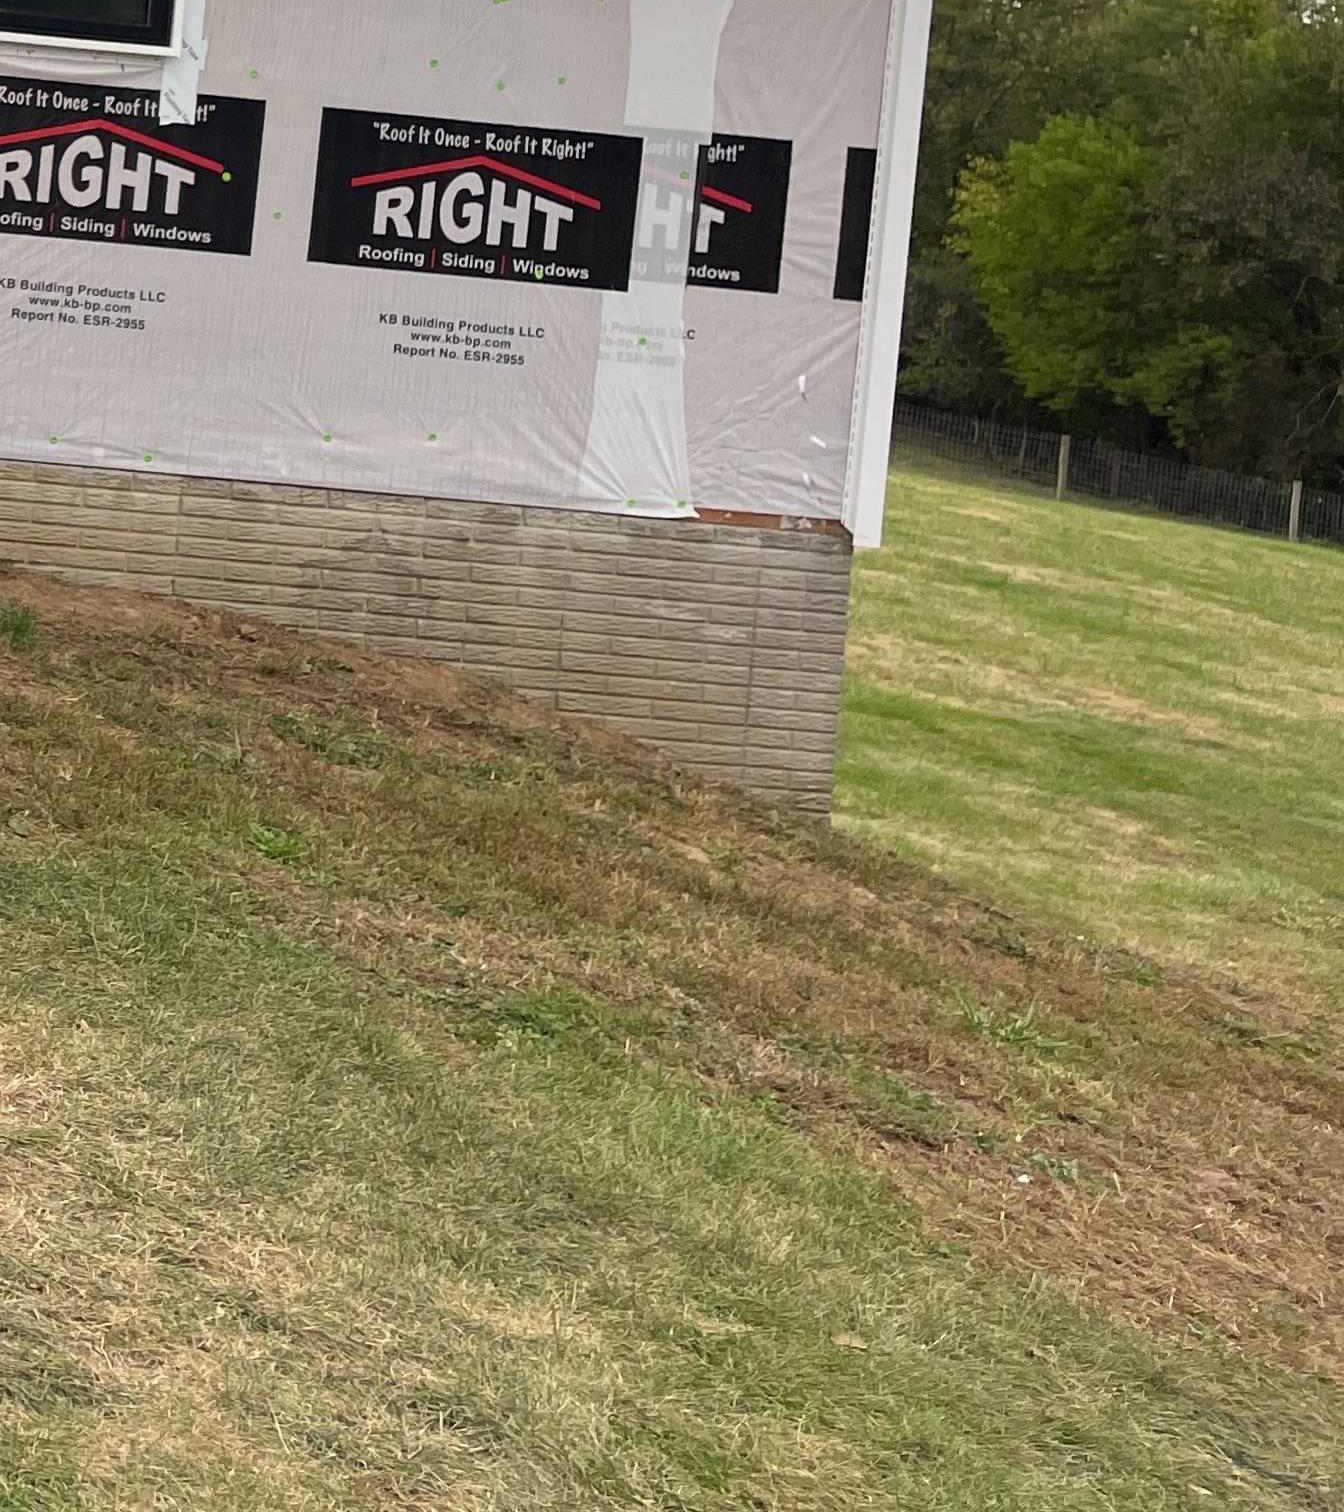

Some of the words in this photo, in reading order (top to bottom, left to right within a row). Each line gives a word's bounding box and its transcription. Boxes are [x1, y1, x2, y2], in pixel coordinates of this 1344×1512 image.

[36, 90, 50, 108] It
[52, 91, 88, 112] Once
[104, 96, 141, 117] Roof
[144, 99, 159, 118] It
[373, 121, 415, 142] "Roof
[418, 126, 431, 144] It
[434, 127, 470, 148] Once
[485, 132, 521, 154] Roof
[524, 136, 539, 156] It
[541, 138, 594, 161] Right!"
[372, 171, 574, 252] RIGHT
[60, 216, 116, 237] Siding
[133, 222, 211, 244] Windows
[358, 244, 425, 267] Roofing
[442, 252, 495, 274] Siding
[20, 279, 74, 297] Building
[77, 284, 135, 300] Products
[139, 290, 166, 303] LLC
[29, 296, 132, 313] www.kb-bp.com
[11, 308, 54, 322] Report
[58, 312, 79, 324] No.
[83, 314, 146, 330] ESR-2955
[379, 313, 398, 325] KB
[402, 315, 454, 332] Building
[459, 320, 515, 337] Products
[518, 326, 545, 339] LLC
[410, 330, 512, 350] www.kb-bp.com
[392, 343, 437, 359] Report
[439, 347, 460, 360] No.
[464, 350, 525, 366] ESR-2955
